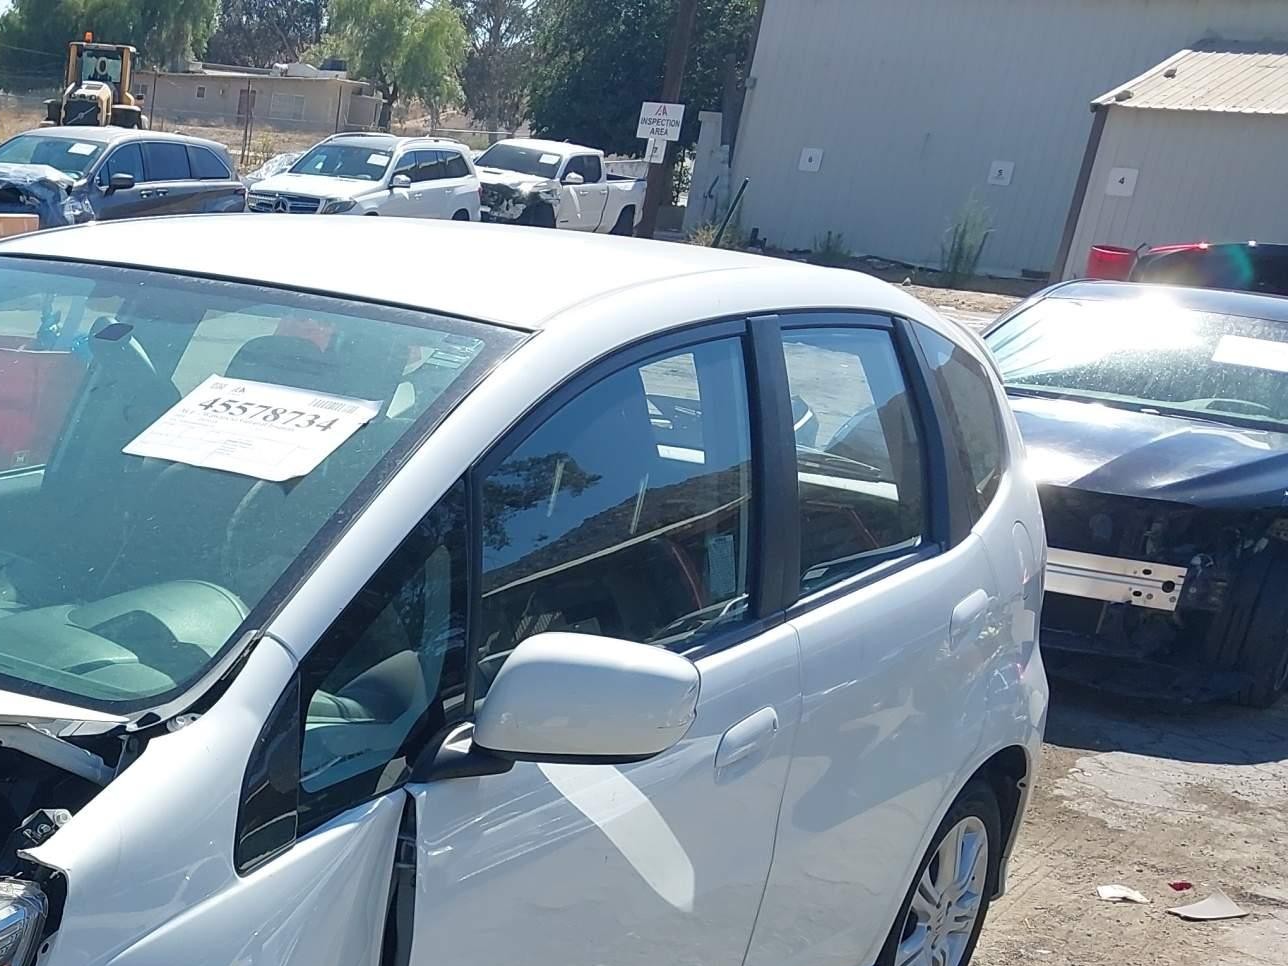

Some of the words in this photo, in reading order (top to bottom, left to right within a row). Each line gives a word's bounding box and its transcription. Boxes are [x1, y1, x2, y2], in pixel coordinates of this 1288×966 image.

[640, 117, 680, 128] INSPECTION
[649, 127, 669, 136] AREA
[1118, 177, 1125, 185] 4
[198, 397, 340, 432] 45578734
